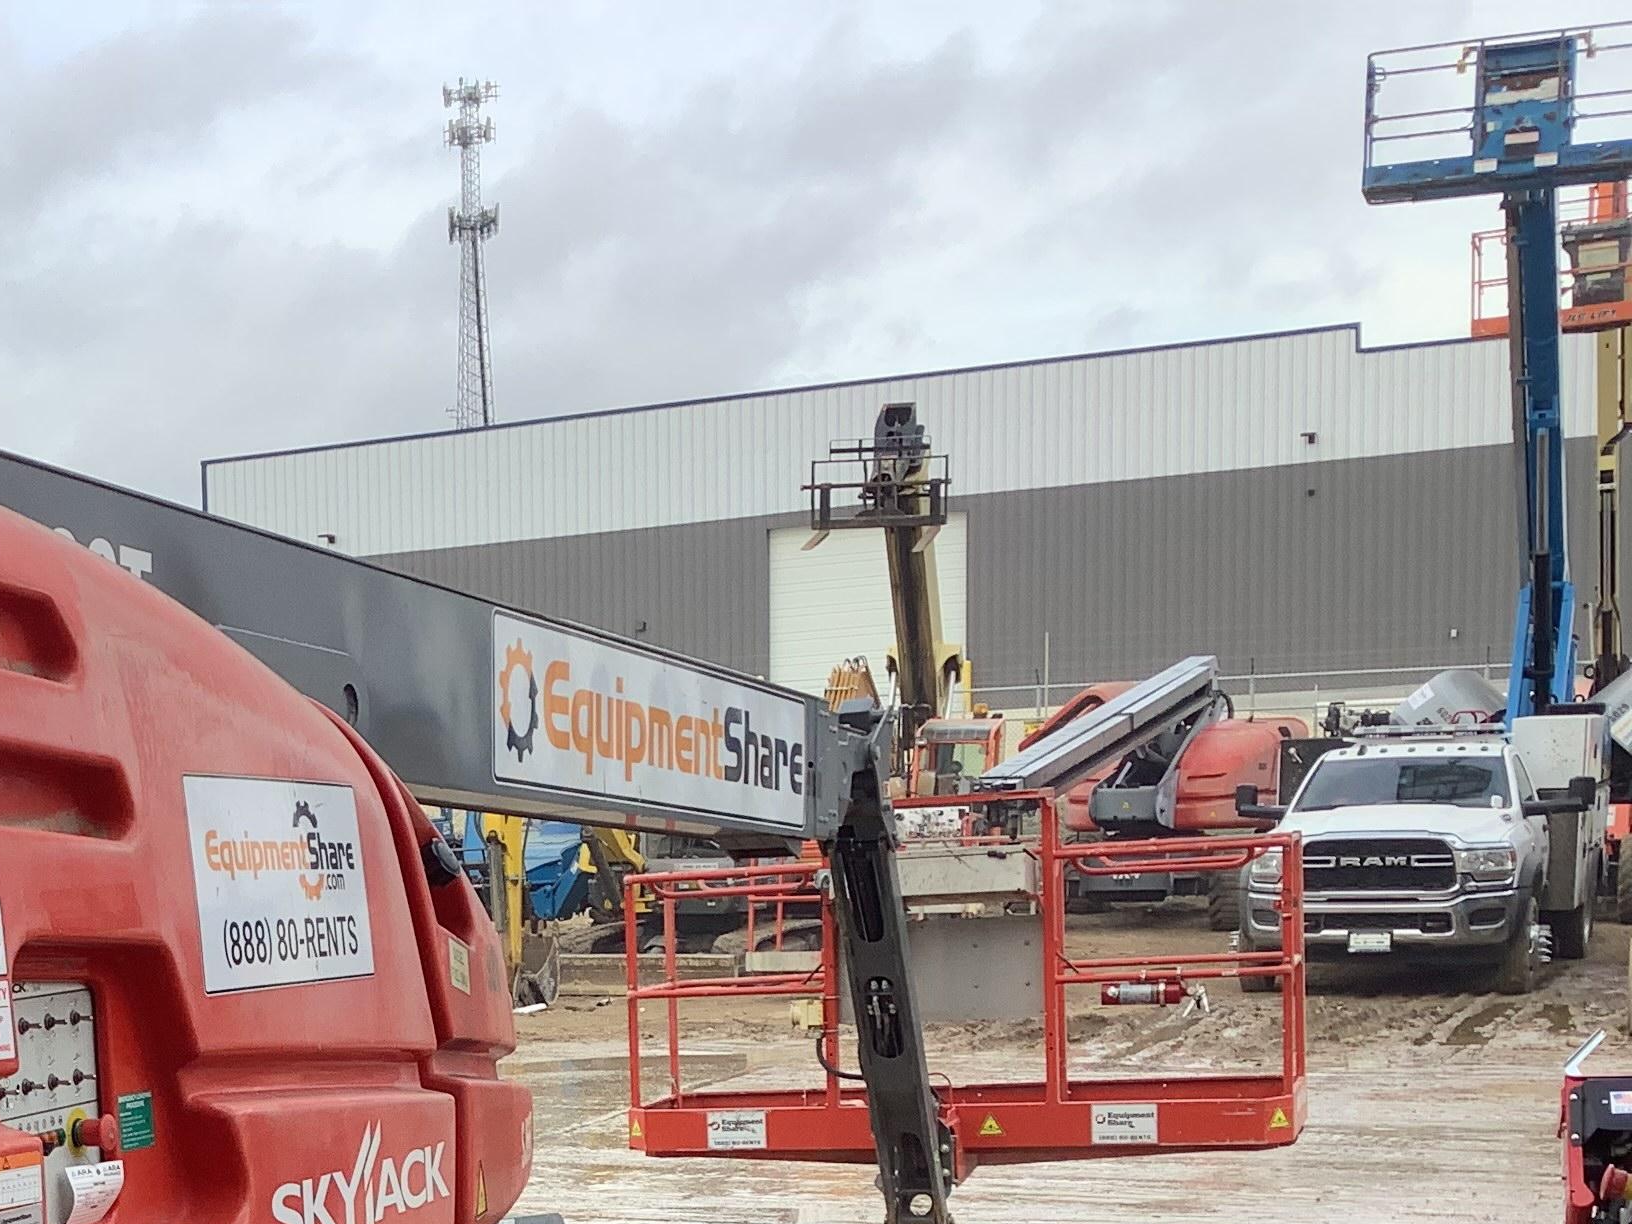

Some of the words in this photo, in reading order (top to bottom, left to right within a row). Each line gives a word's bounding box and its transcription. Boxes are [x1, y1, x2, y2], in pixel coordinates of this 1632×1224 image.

[543, 659, 803, 796] EquipmentShare
[204, 829, 355, 880] EquipmentShare
[1340, 856, 1408, 866] RAM
[325, 874, 346, 890] .com
[224, 917, 272, 969] (888)
[277, 915, 359, 961] 80-RENTS
